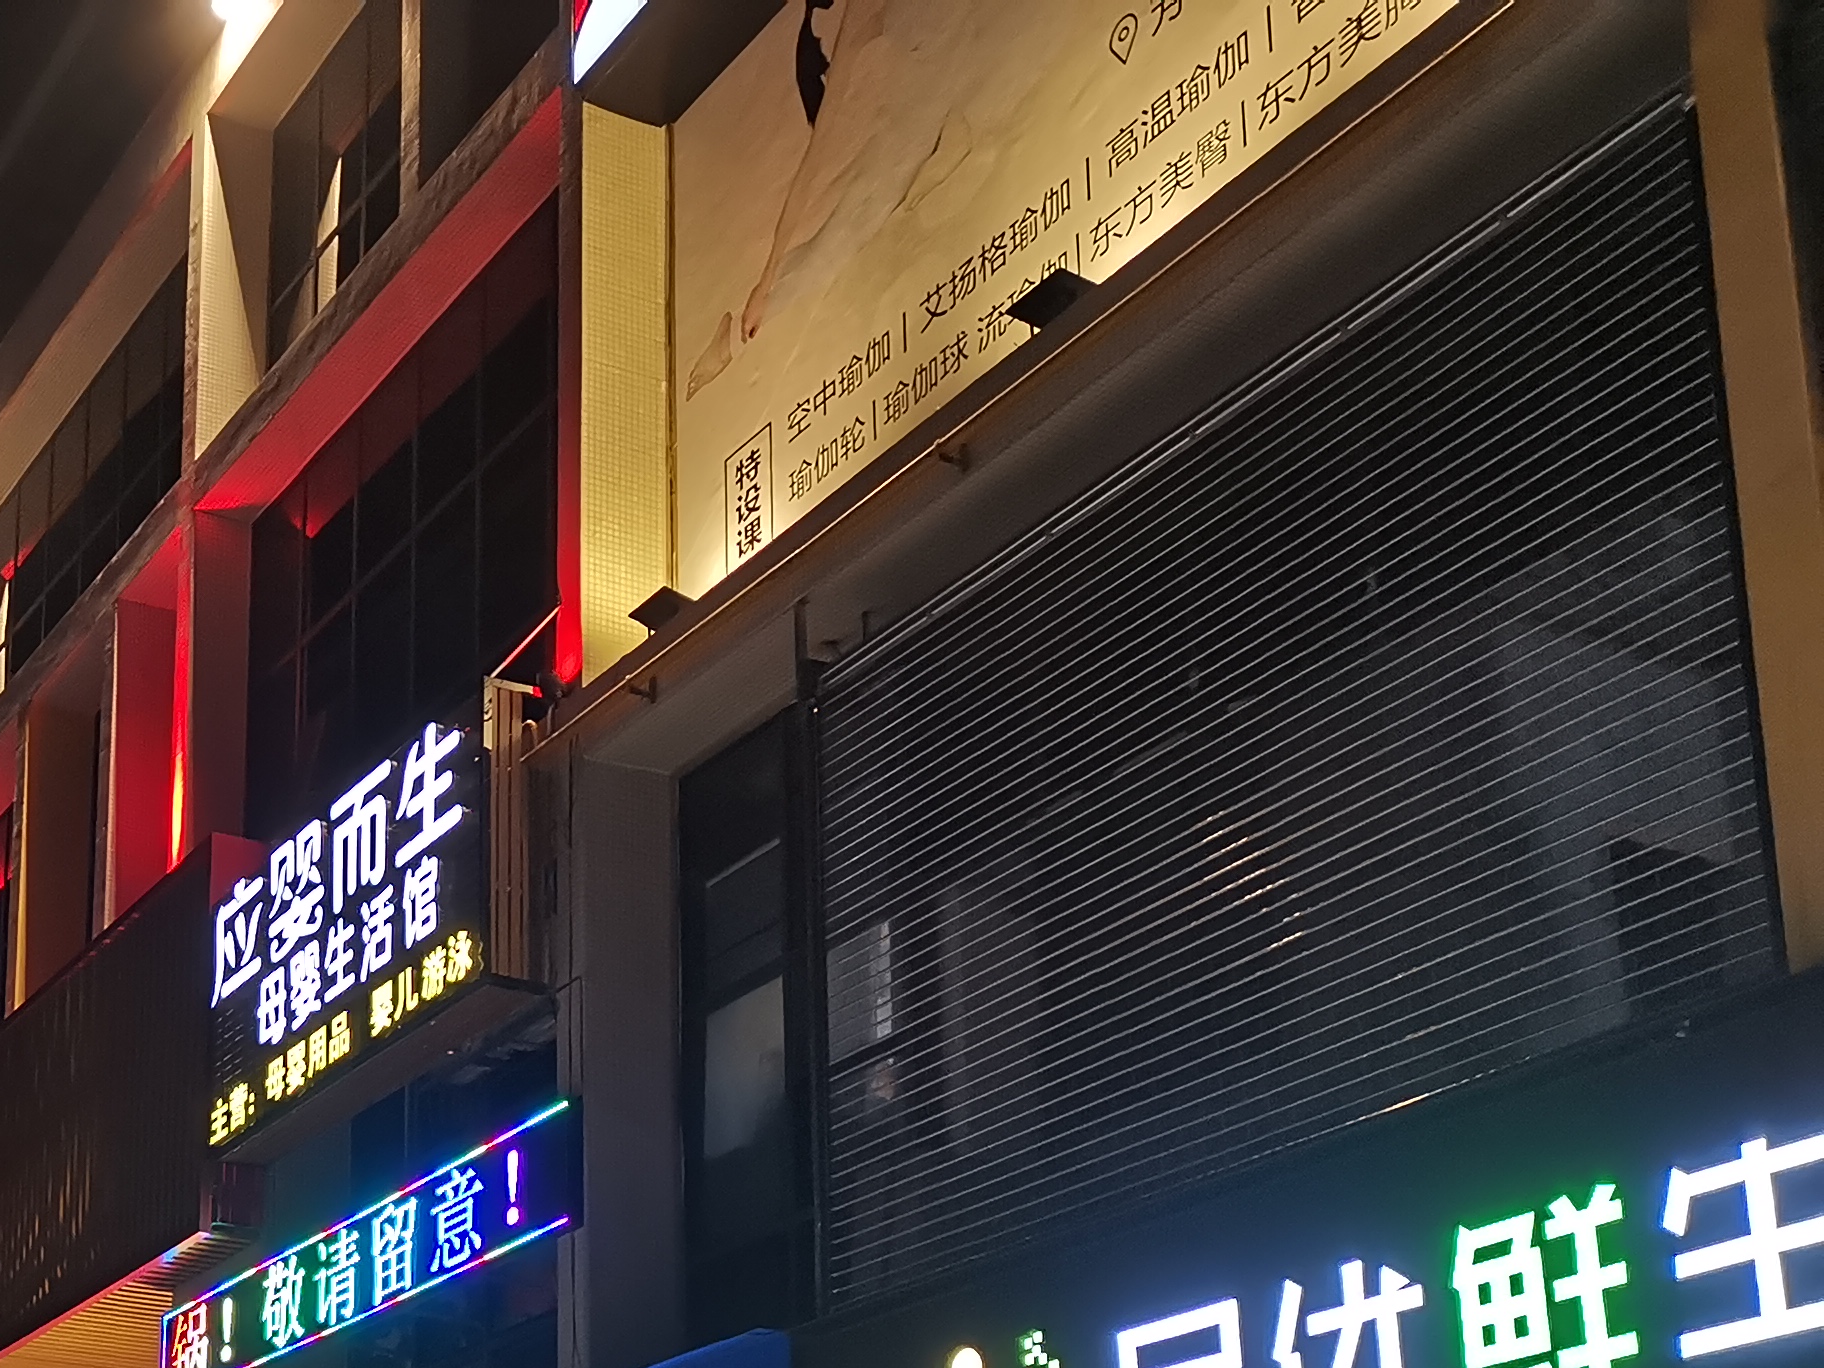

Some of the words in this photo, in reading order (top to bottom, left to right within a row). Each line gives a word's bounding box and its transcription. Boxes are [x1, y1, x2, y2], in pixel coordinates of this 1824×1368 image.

[787, 331, 890, 443] 空中瑜伽
[919, 177, 1071, 333] 艾扬格瑜伽
[1105, 30, 1249, 177] 高温瑜伽
[788, 416, 865, 502] 瑜伽轮
[883, 331, 969, 427] 瑜伽球
[1089, 118, 1231, 262] 东方美臀
[735, 448, 762, 558] 特设课
[211, 722, 464, 1008] 应婴而生
[256, 856, 440, 1045] 母婴生活馆
[265, 1010, 352, 1101] 母婴用品
